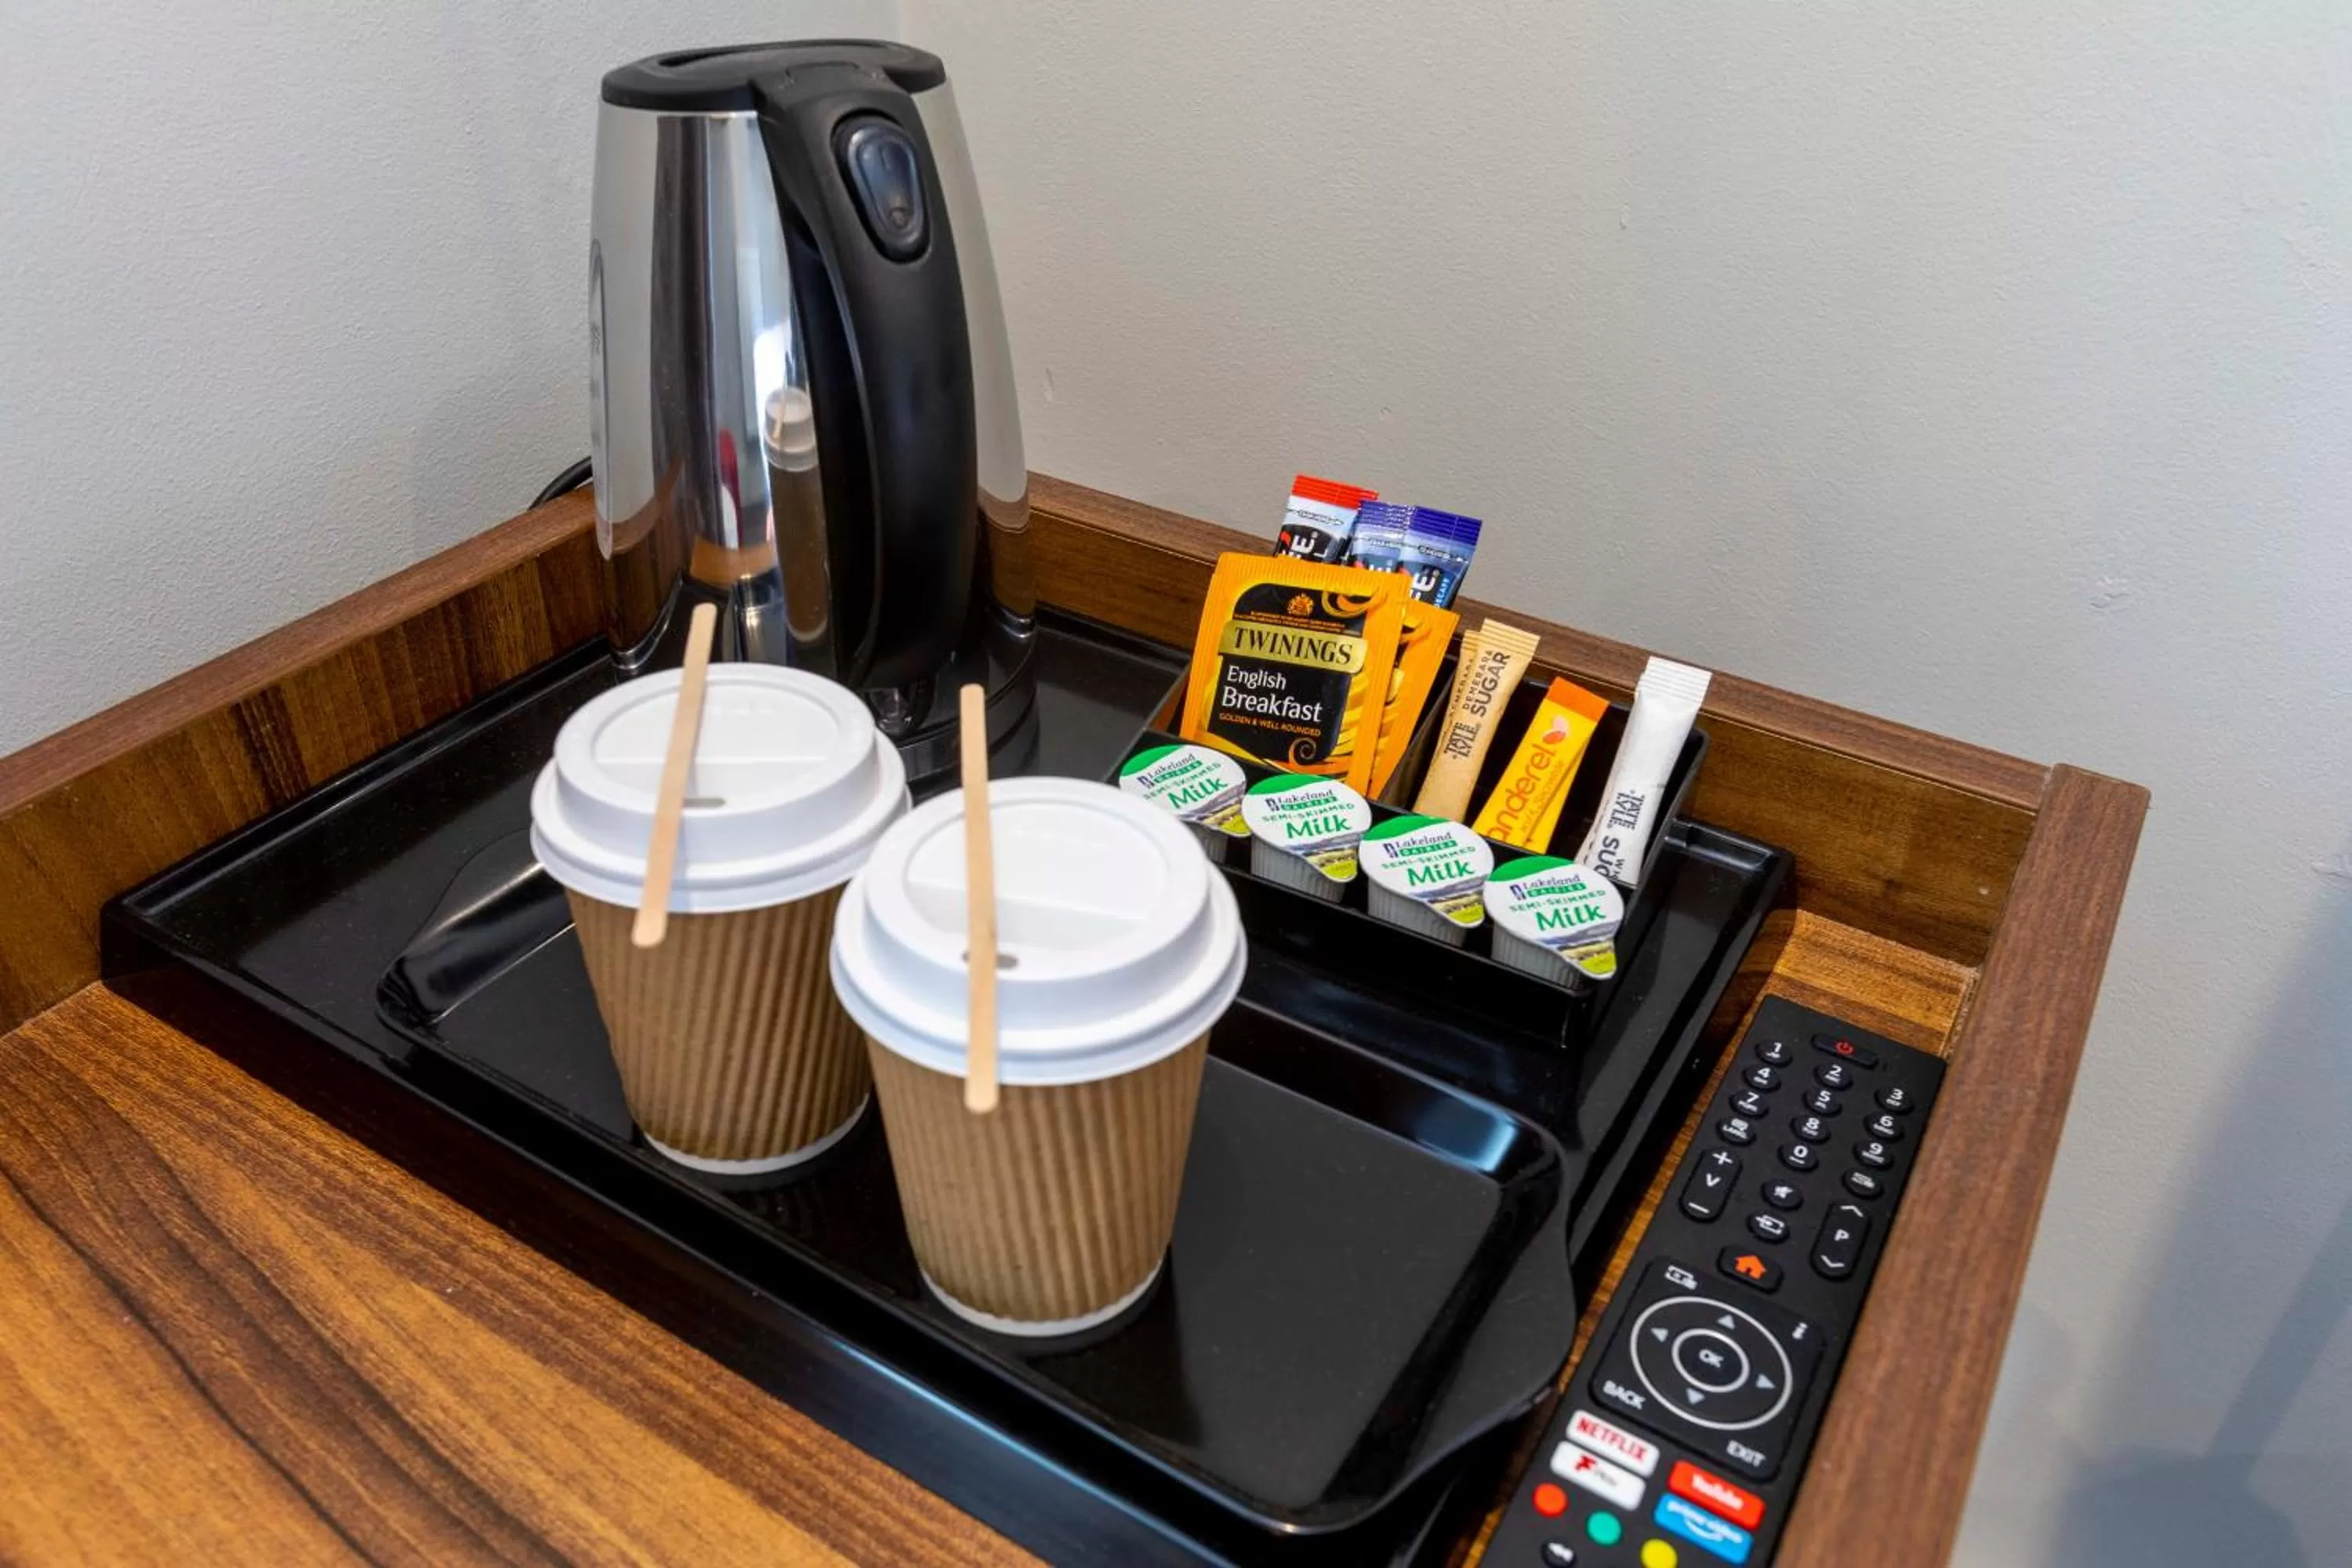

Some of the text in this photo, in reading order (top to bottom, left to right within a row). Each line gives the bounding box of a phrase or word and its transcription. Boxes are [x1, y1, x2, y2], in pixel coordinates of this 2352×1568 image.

[1235, 627, 1353, 665] TWININGS
[1227, 665, 1287, 690] English
[1462, 651, 1494, 710] DEMERARA
[1470, 652, 1511, 717] SUGAR
[1222, 687, 1323, 722] Breakfast
[1219, 713, 1251, 725] GOLDEN
[1259, 720, 1279, 730] WELL
[1281, 724, 1321, 737] ROUNDED
[1444, 722, 1466, 754] TATE
[1456, 725, 1479, 758] LYLE
[1149, 753, 1196, 779] Lakeland
[1167, 778, 1228, 809] Milk
[1278, 789, 1333, 804] Lakeland
[1487, 743, 1557, 842] anderel
[1262, 803, 1355, 822] SEMI-SKIMMED
[1610, 792, 1631, 827] LYLE
[1624, 793, 1646, 830] TATE
[1286, 815, 1352, 839] Milk
[1396, 832, 1451, 848] Lakeland
[1381, 846, 1476, 869] SEMI-SKIMMED
[1407, 859, 1475, 886] Milk
[1523, 874, 1581, 889] Lakeland
[1509, 890, 1606, 911] SEMI-SKIMMED
[1536, 904, 1606, 931] Milk
[1773, 1042, 1782, 1053] 1
[1758, 1068, 1770, 1078] 4
[1830, 1065, 1842, 1076] 2
[1747, 1092, 1759, 1104] 7
[1818, 1090, 1831, 1102] 5
[1891, 1088, 1904, 1101] 3
[1806, 1117, 1820, 1130] 8
[1880, 1115, 1894, 1127] 6
[1794, 1145, 1808, 1158] 0
[1869, 1142, 1884, 1155] 9
[1835, 1229, 1849, 1241] P
[1698, 1348, 1724, 1367] OK
[1603, 1380, 1646, 1410] BACK
[1577, 1417, 1646, 1462] NETFLIX
[1727, 1440, 1766, 1467] EXIT
